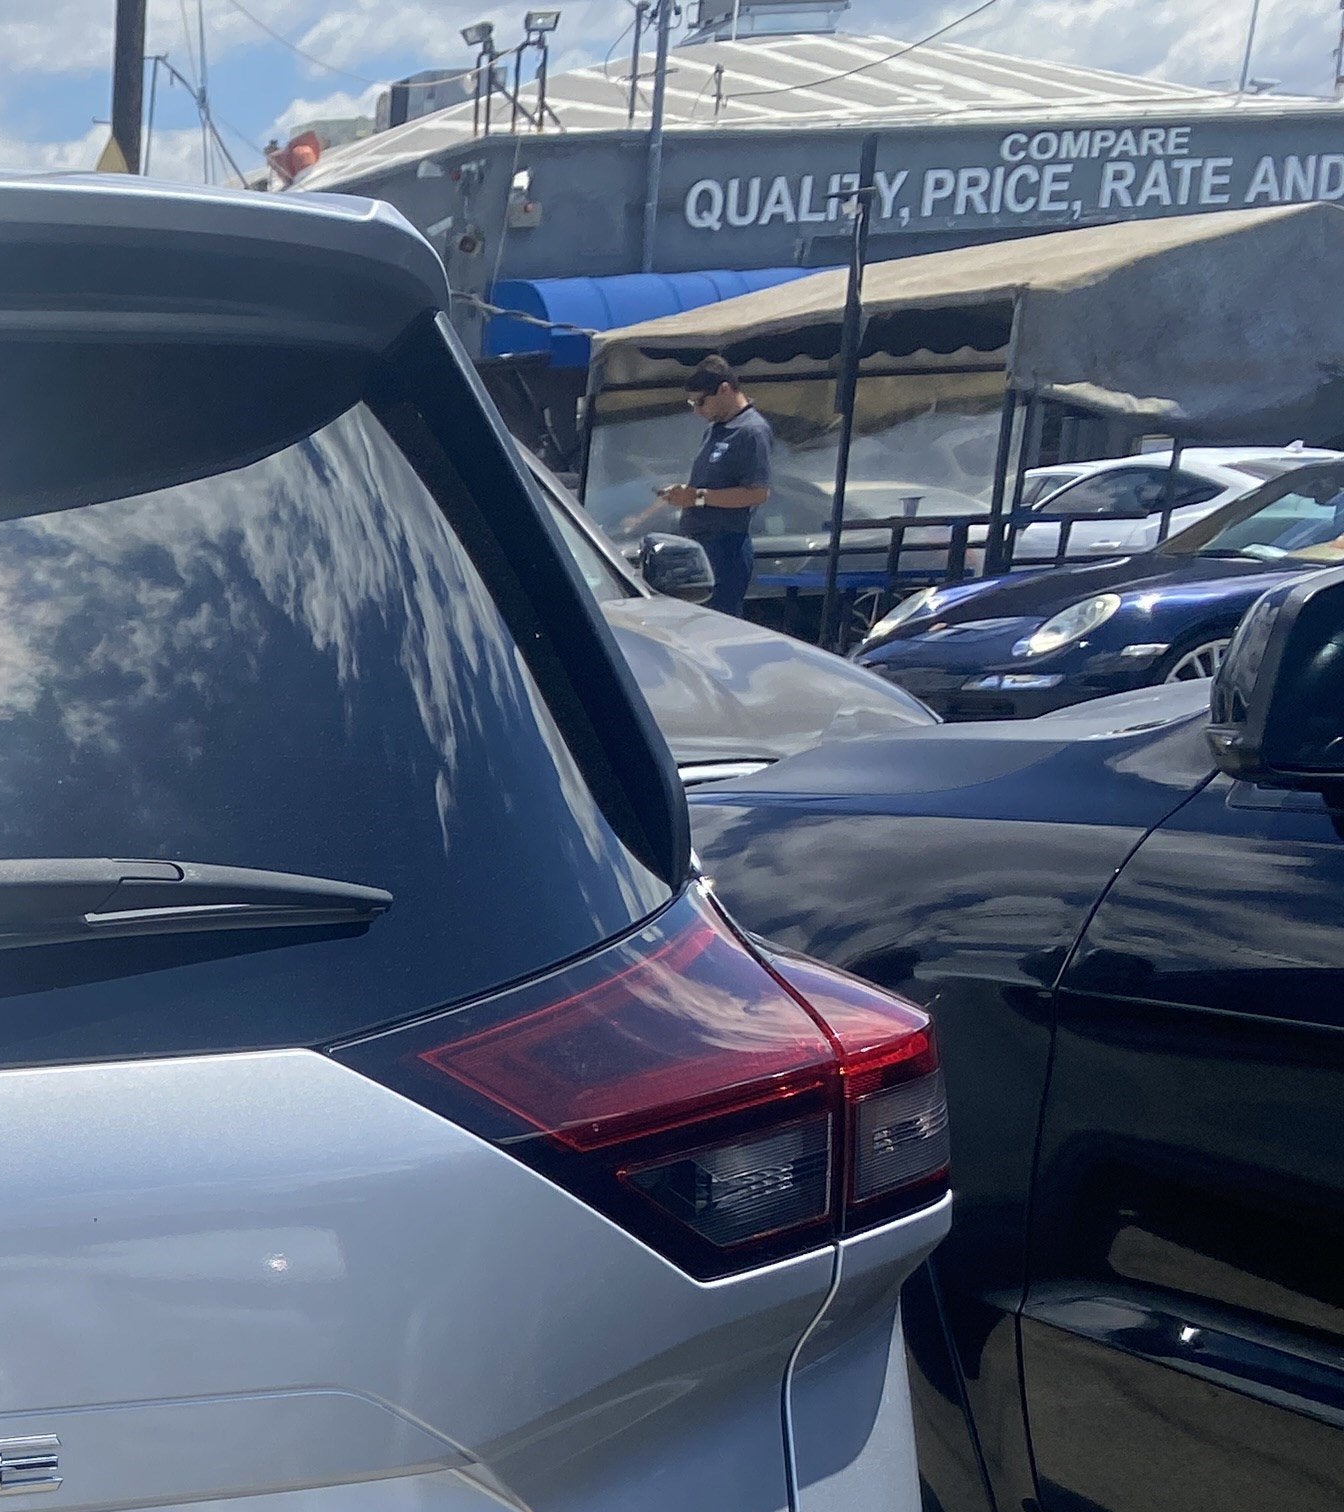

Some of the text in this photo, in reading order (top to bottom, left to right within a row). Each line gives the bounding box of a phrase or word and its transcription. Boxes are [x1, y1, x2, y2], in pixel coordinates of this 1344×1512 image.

[1001, 127, 1191, 161] COMPARE
[921, 163, 1082, 220] PRICE,
[1099, 157, 1233, 209] RATE
[1244, 154, 1344, 203] AND
